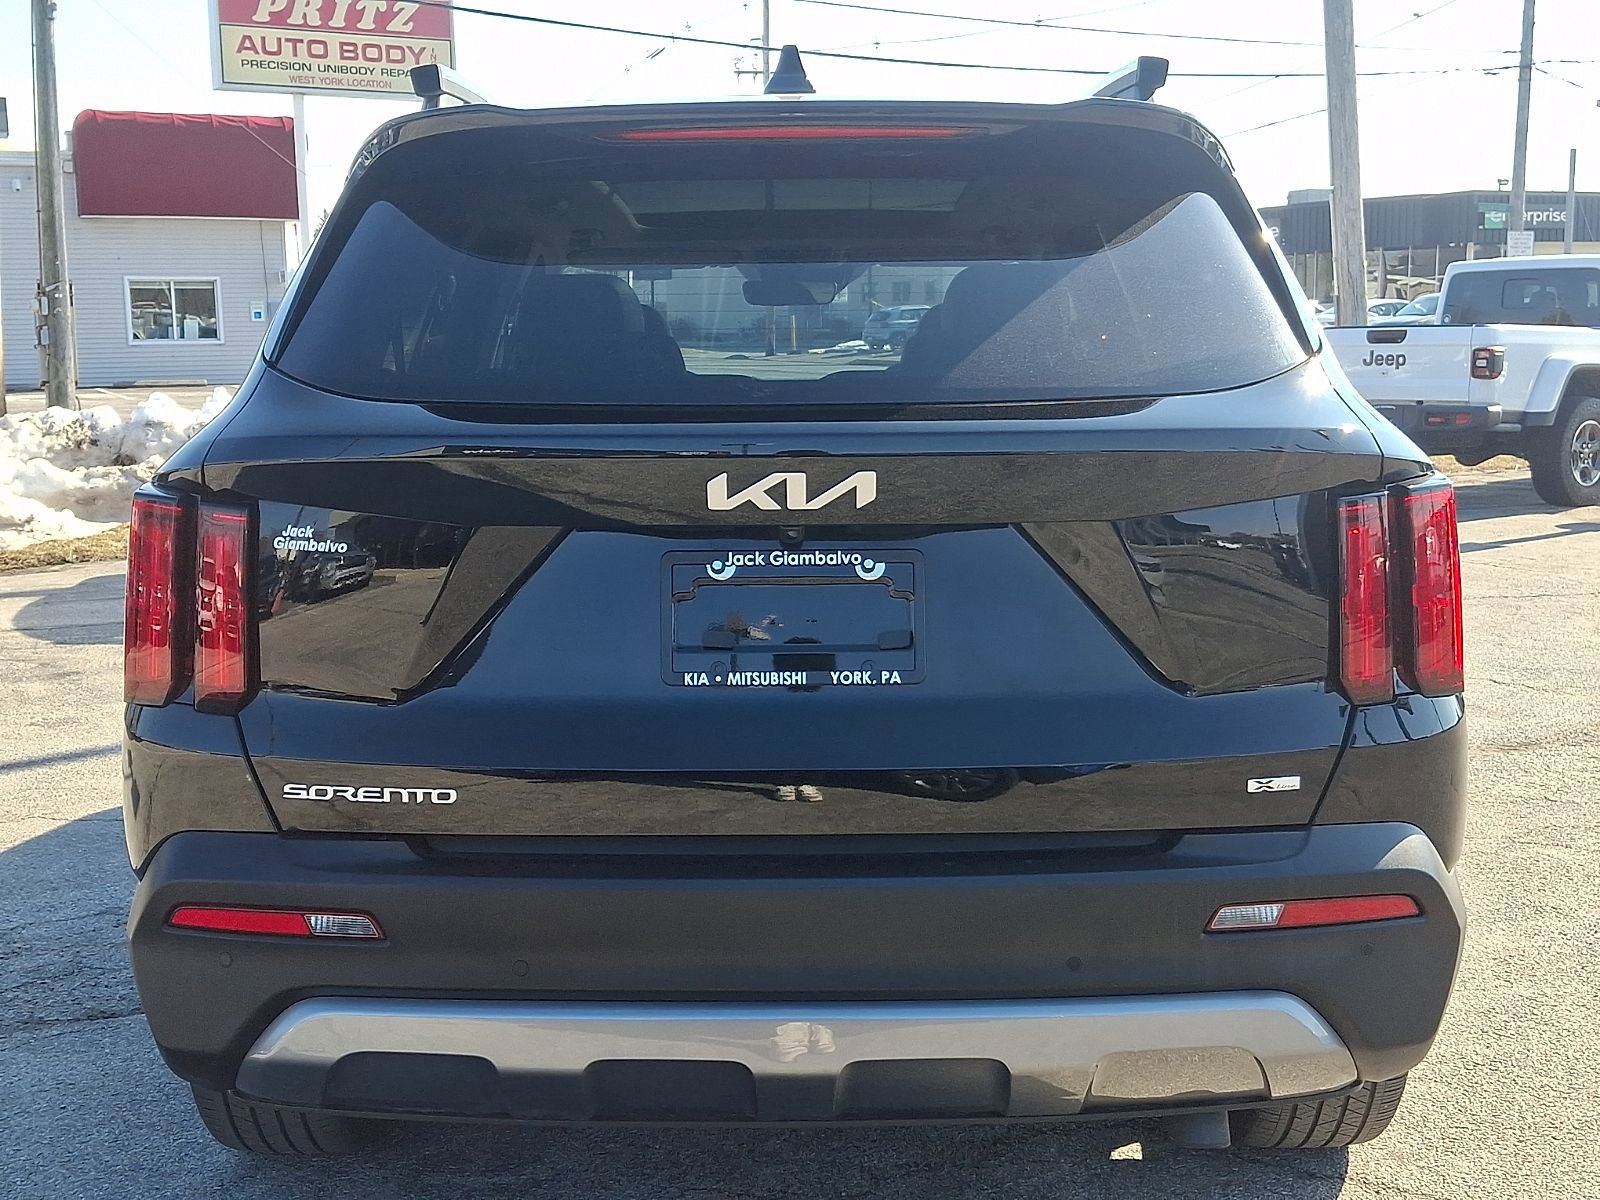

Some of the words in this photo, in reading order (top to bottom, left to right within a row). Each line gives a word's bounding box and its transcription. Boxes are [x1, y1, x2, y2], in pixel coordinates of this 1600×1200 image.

[252, 0, 420, 33] PRITZ
[236, 35, 329, 59] AUTO
[339, 42, 427, 65] BODY
[241, 59, 312, 72] PRECISION
[317, 64, 376, 76] UNIBODY
[381, 68, 412, 78] REPA
[289, 75, 316, 85] WEST
[319, 77, 344, 88] YORK
[347, 79, 392, 89] LOCATION
[1362, 350, 1407, 370] Jeep
[706, 470, 877, 511] KIA
[282, 524, 315, 538] Jack
[273, 536, 348, 553] Giambalvo
[725, 550, 766, 566] Jack
[769, 550, 862, 566] Giambalvo
[684, 672, 710, 686] KIA
[727, 671, 807, 686] MITSUBISHI
[830, 671, 877, 685] YORK,
[881, 671, 902, 685] PA
[282, 783, 458, 804] SORENTO
